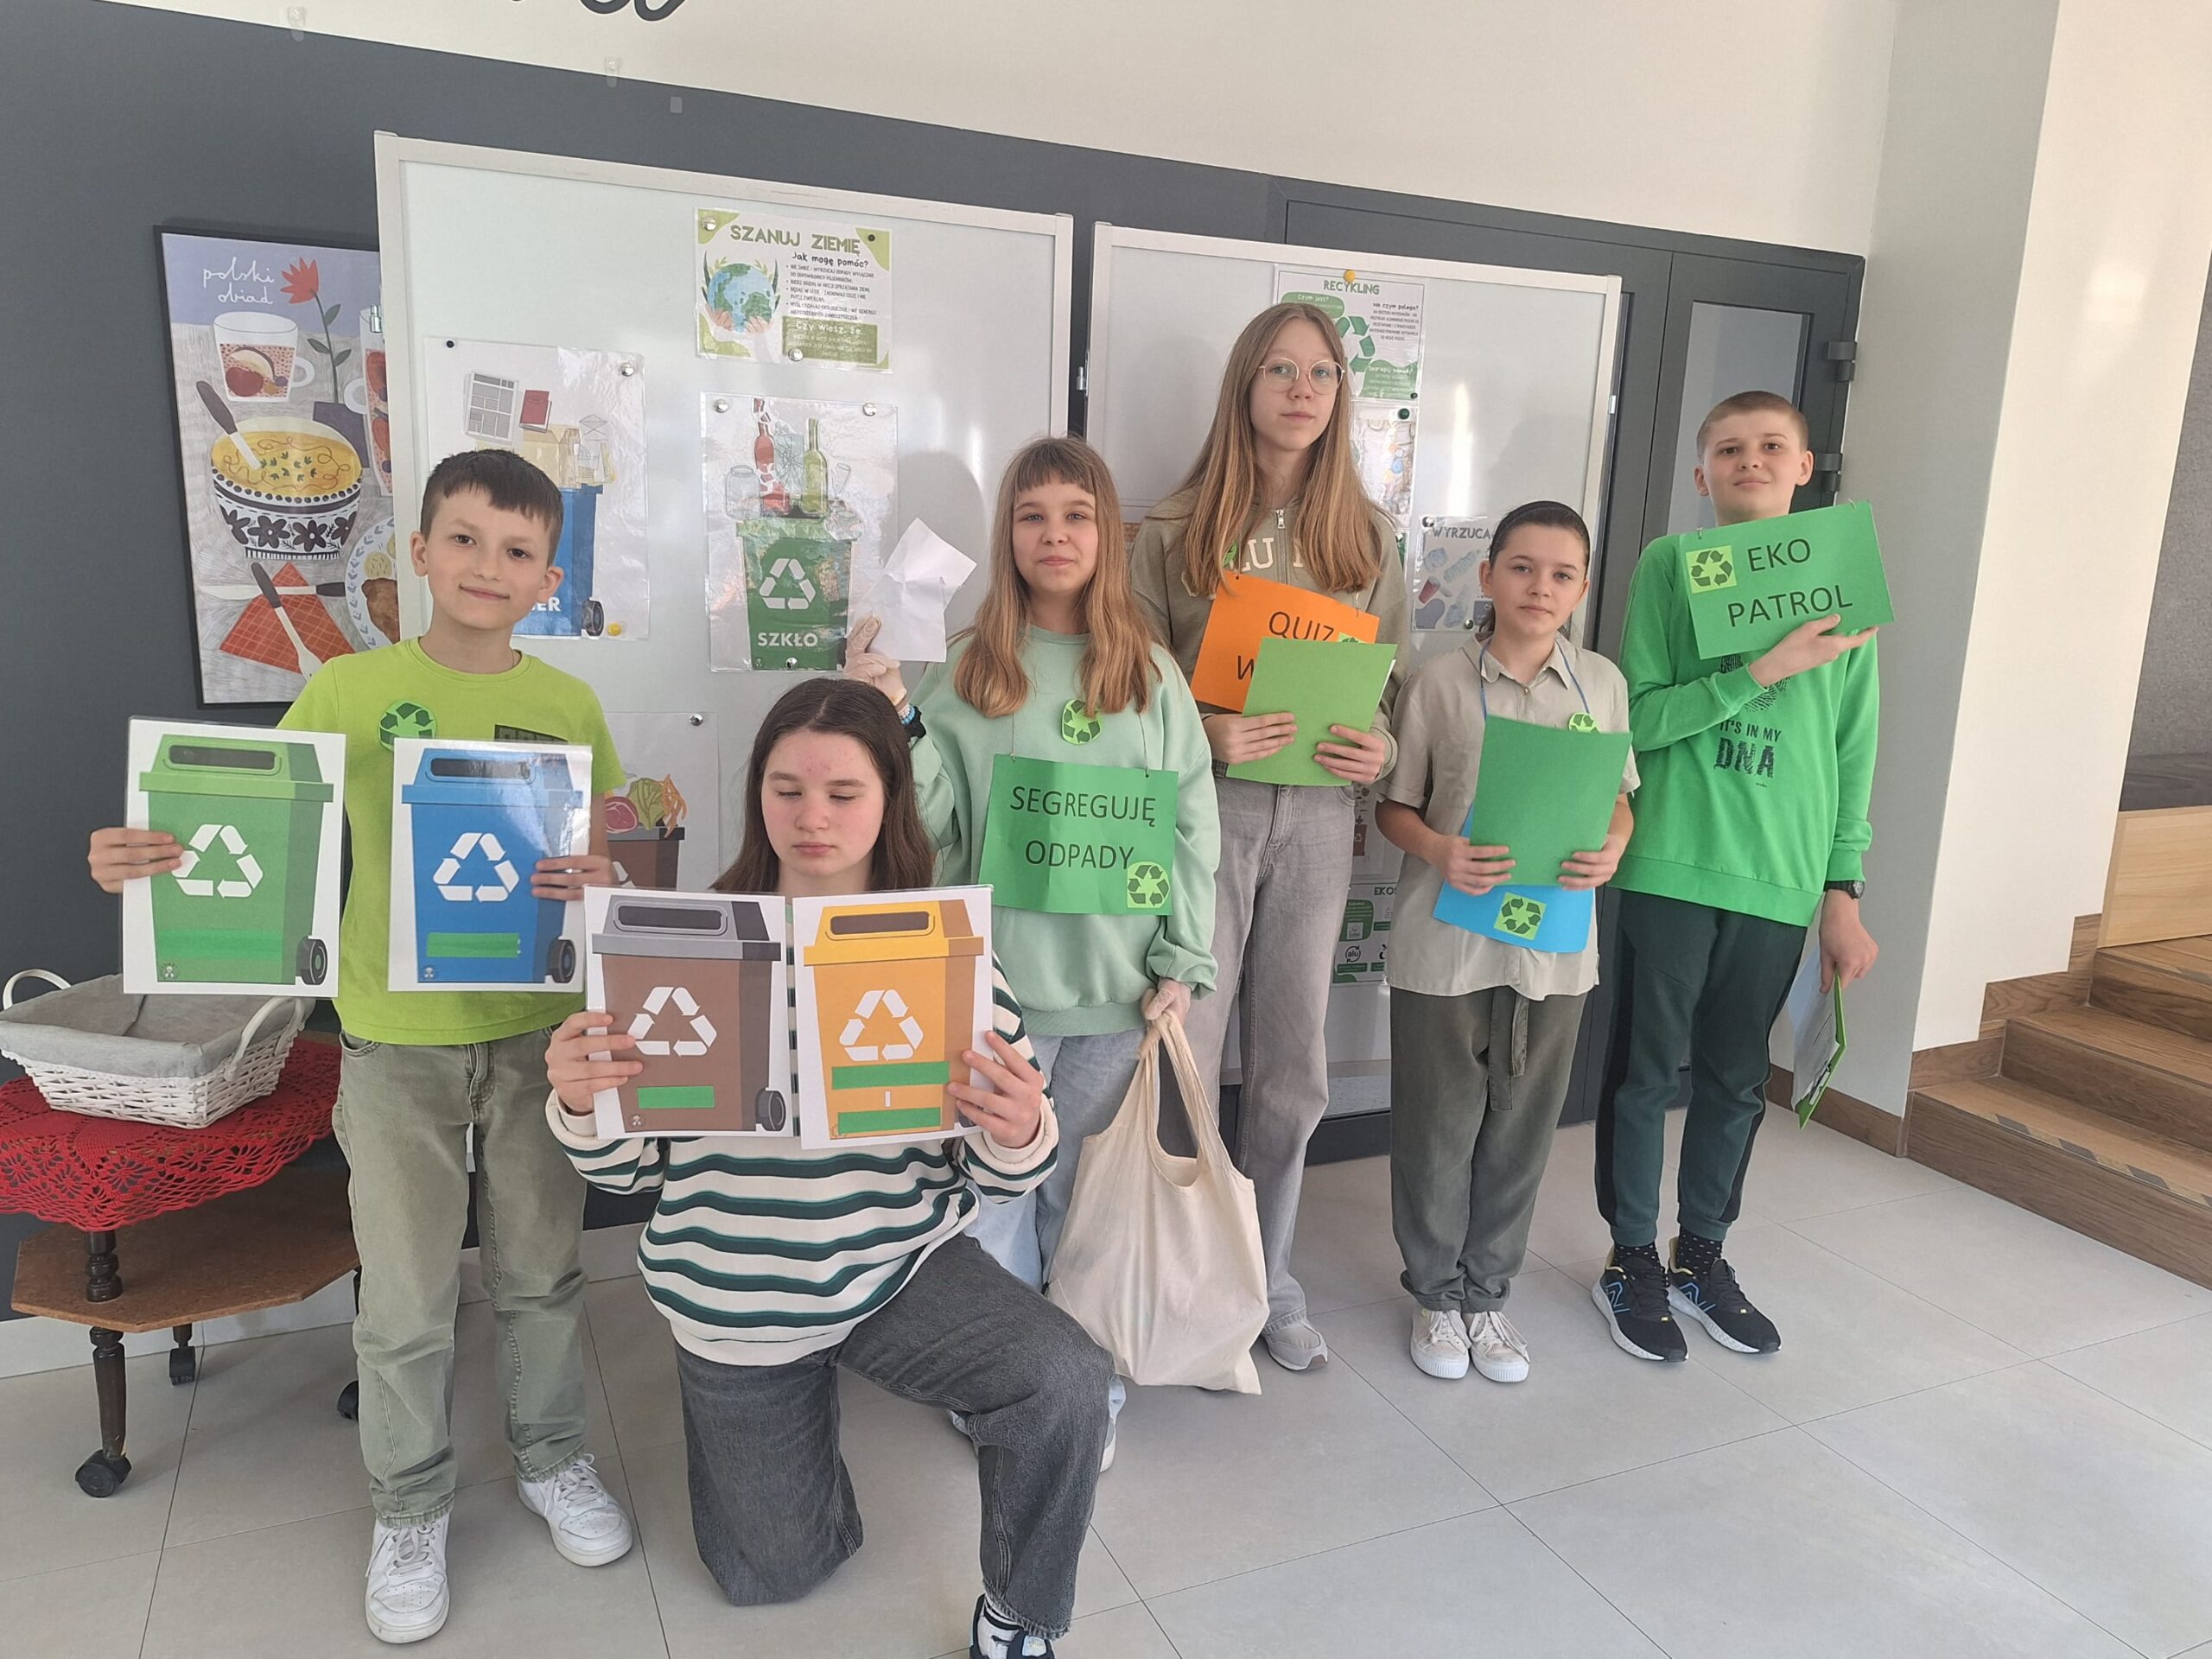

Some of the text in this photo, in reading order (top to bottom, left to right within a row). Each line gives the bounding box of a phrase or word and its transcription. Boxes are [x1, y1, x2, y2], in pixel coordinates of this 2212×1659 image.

[730, 225, 861, 257] SZANUJ ZIEMIĘ
[203, 257, 275, 289] polski
[792, 252, 869, 268] Jak mogę pomóc?
[218, 282, 273, 304] obiad
[1323, 280, 1380, 295] RECYKLING
[796, 321, 814, 332] Czy
[1747, 538, 1811, 573] EKO
[1727, 585, 1853, 627] PATROL
[758, 632, 818, 647] SZKŁO
[1268, 611, 1335, 642] QUIZ
[1719, 719, 1782, 743] IT'S IN MY
[1713, 736, 1775, 779] DNA
[1009, 785, 1156, 827] SEGREGUJĘ
[1025, 840, 1135, 869] ODPADY
